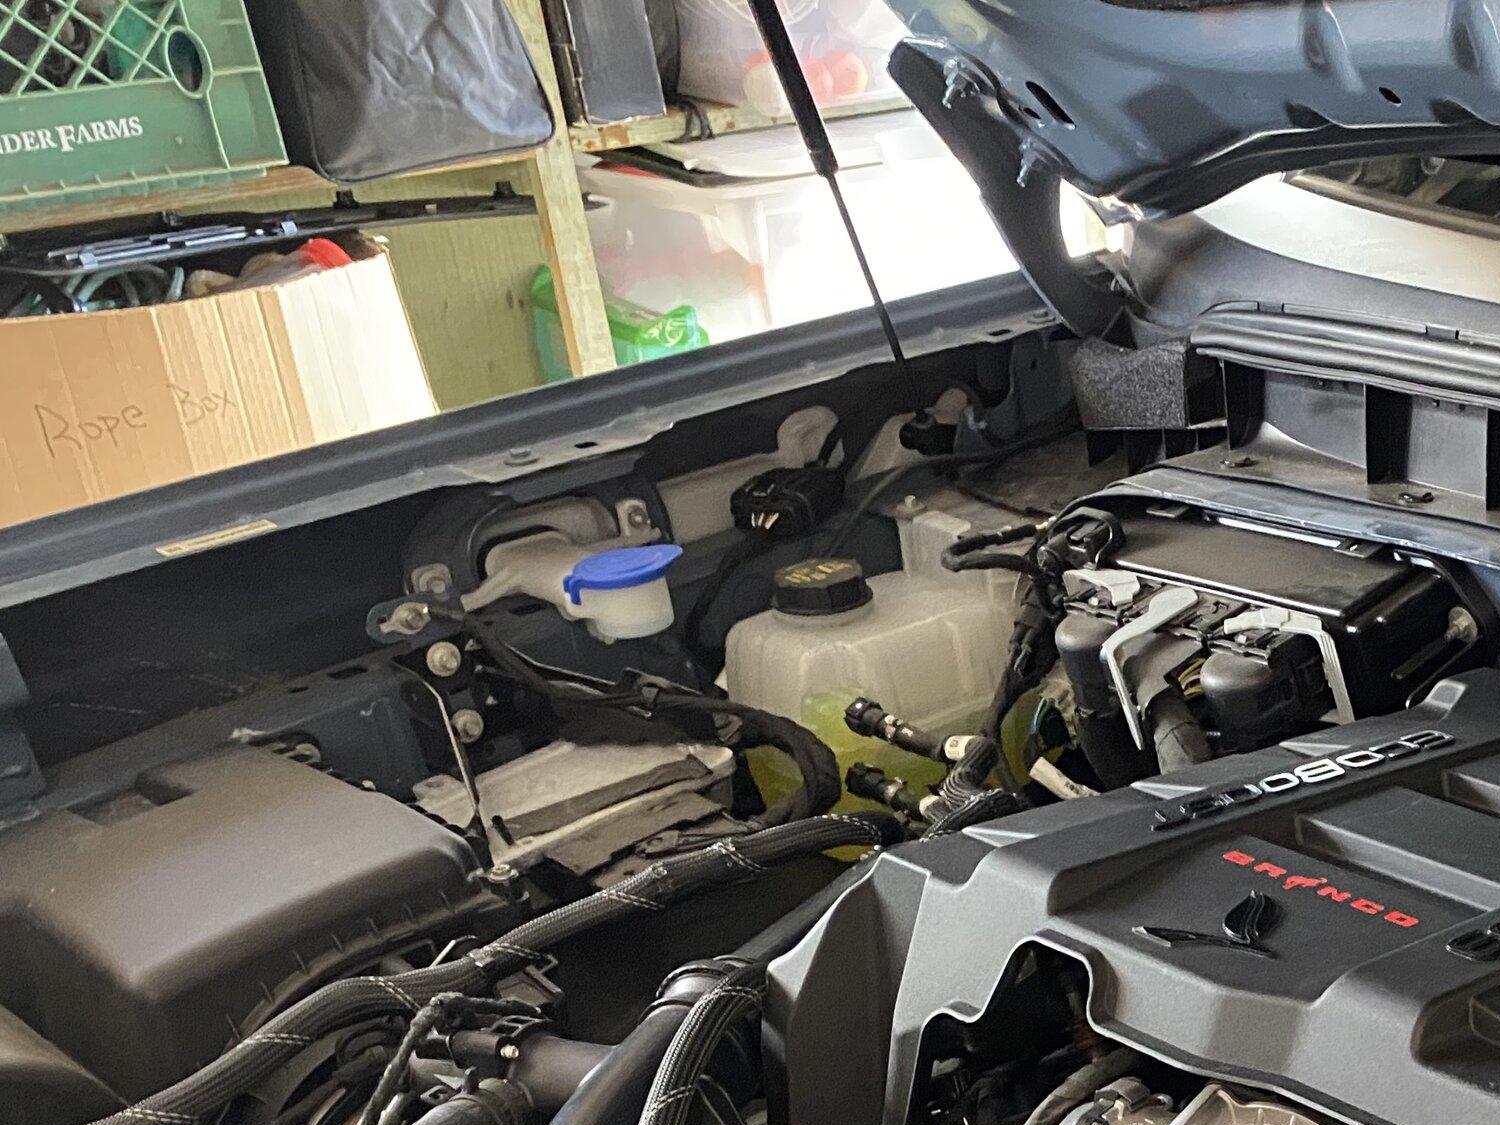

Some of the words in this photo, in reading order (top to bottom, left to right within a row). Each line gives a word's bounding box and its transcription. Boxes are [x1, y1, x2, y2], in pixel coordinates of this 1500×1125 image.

[54, 116, 143, 152] FARMS
[35, 404, 147, 458] Rope
[166, 383, 237, 427] Box
